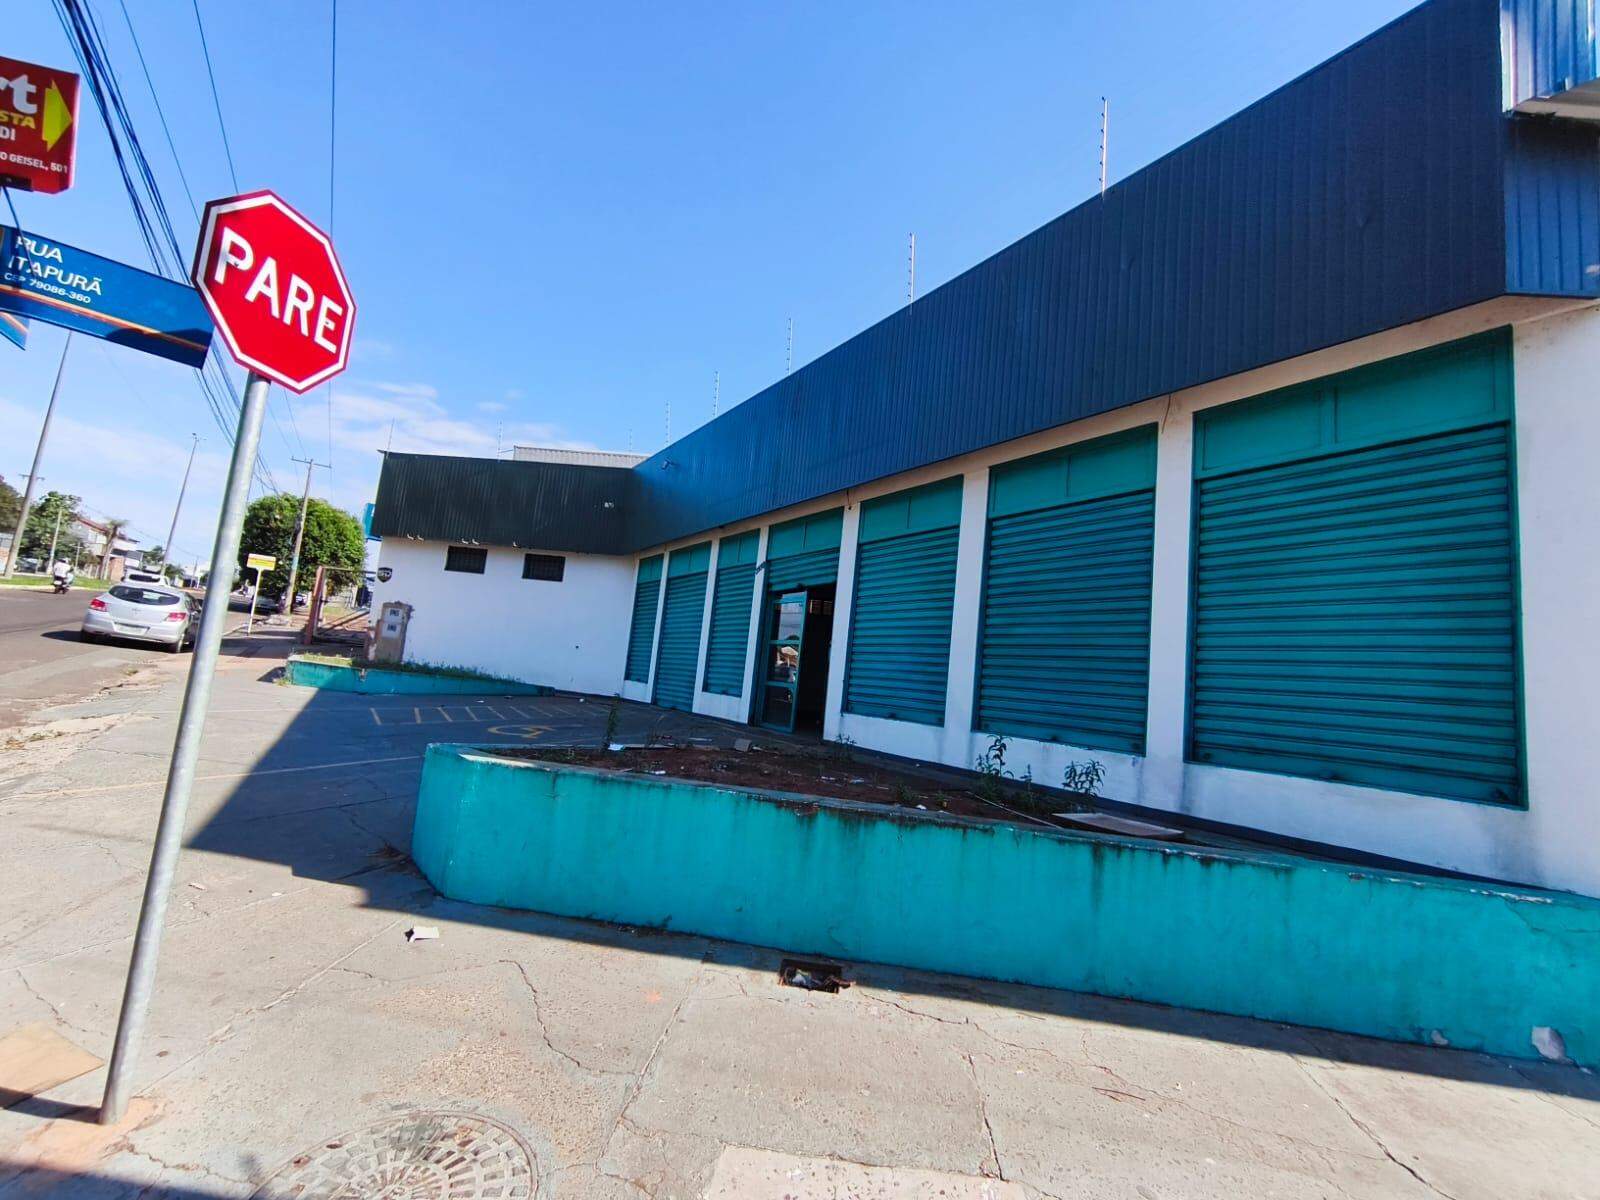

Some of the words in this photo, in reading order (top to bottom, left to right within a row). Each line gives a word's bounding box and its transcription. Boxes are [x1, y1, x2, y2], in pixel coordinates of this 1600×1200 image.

[9, 153, 48, 171] GEISEL,
[15, 236, 63, 263] RUA
[8, 255, 102, 295] ITAPURÃ
[214, 226, 343, 354] PARE
